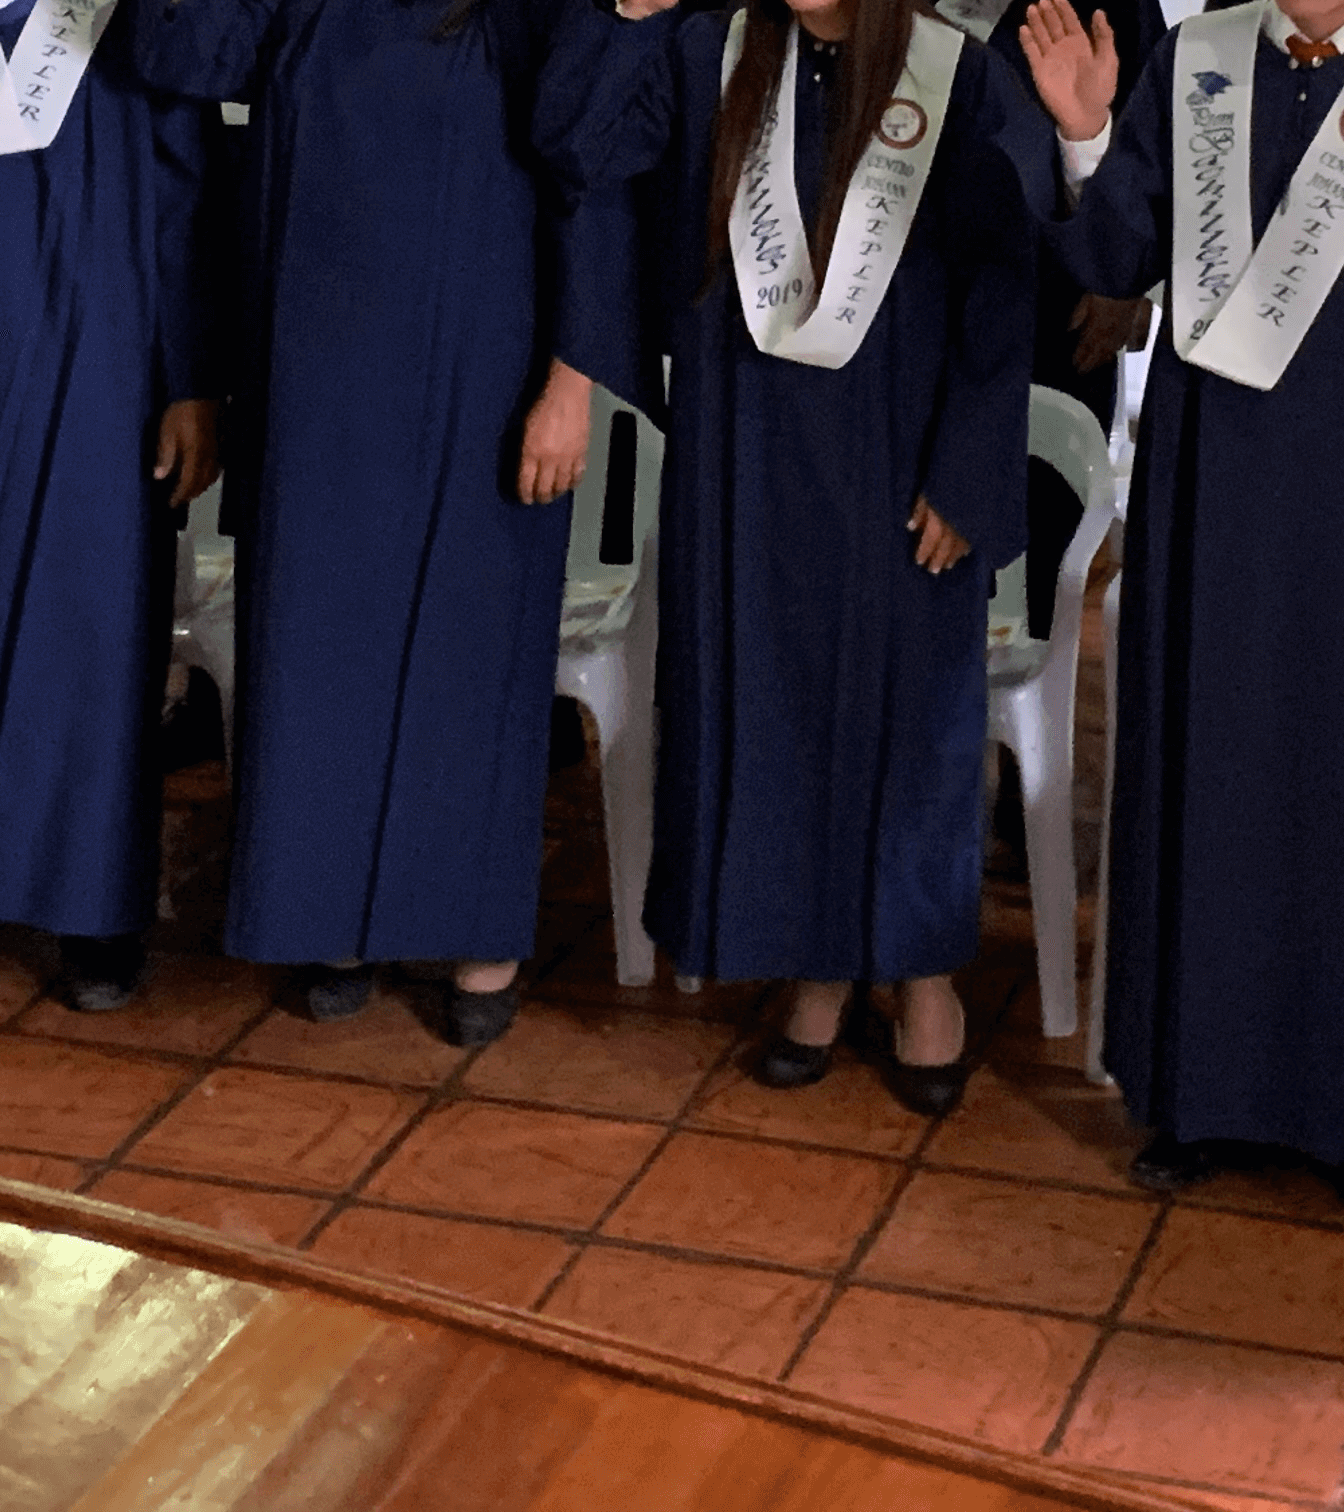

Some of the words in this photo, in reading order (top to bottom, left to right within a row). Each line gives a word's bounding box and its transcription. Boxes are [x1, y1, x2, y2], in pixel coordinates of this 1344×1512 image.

[17, 5, 87, 122] KEPLER
[867, 152, 915, 177] CENTRO
[756, 278, 803, 309] 2019
[835, 195, 899, 324] KEPLER
